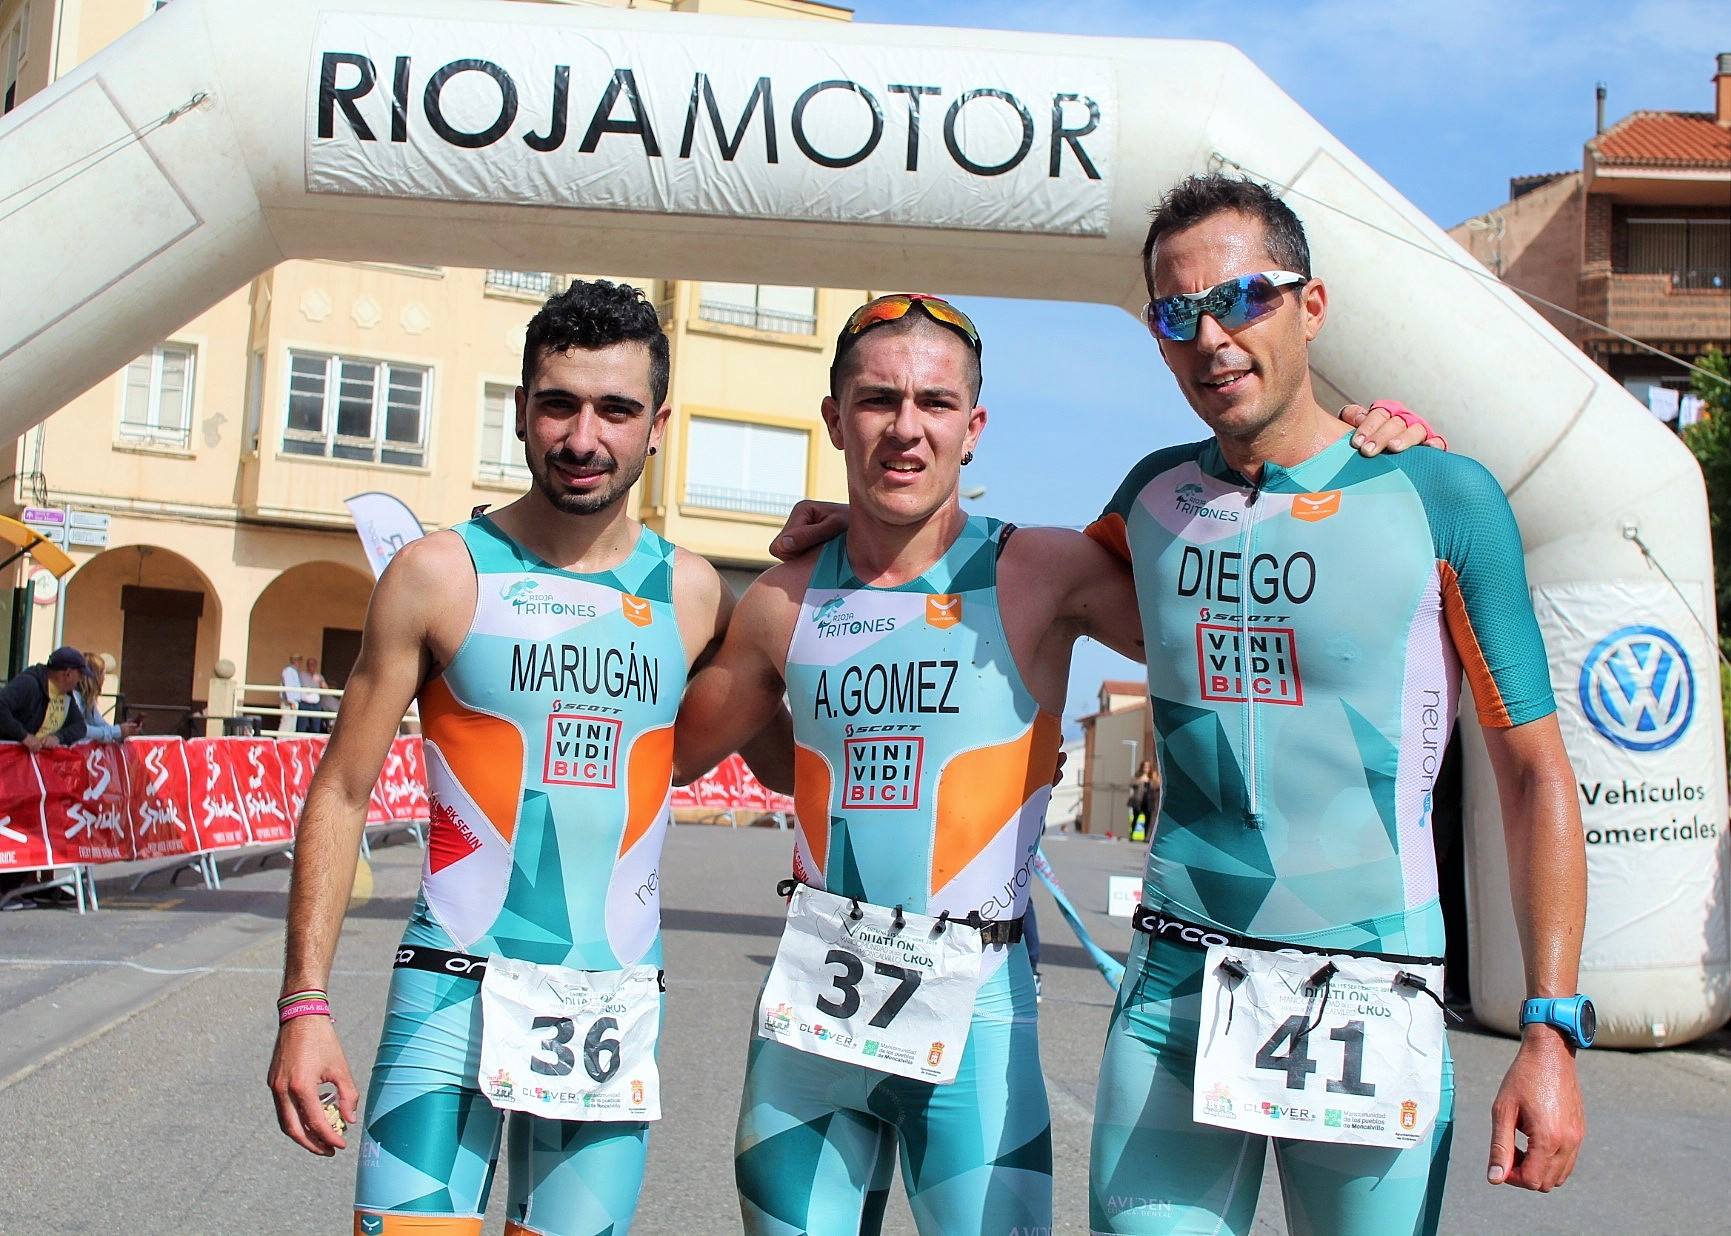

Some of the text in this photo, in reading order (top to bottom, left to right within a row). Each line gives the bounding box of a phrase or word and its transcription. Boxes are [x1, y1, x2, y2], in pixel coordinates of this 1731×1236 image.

[317, 52, 1102, 180] RIOJAMOTOR
[1176, 501, 1239, 523] TRITONES
[1177, 545, 1317, 605] DIEGO
[515, 603, 596, 618] TRITONES
[832, 612, 855, 622] RIOJA
[1212, 612, 1291, 623] SCOTT
[817, 617, 896, 639] TRITONES
[1208, 632, 1282, 653] VINI
[510, 641, 659, 705] MARUGÁN
[1209, 654, 1286, 675] VIDI
[814, 660, 960, 720] A.GOMEZ
[1211, 675, 1288, 696] BICI
[561, 702, 623, 714] SCOTT
[556, 722, 612, 741] VINI
[855, 723, 922, 734] SCOTT
[555, 742, 610, 760] VIDI
[1420, 690, 1441, 793] neuron
[852, 744, 912, 762] VINI
[553, 761, 608, 780] BICI
[852, 764, 911, 782] VIDI
[850, 784, 909, 801] BICI
[1580, 778, 1705, 806] Vehículos
[1585, 815, 1717, 845] omerciales
[815, 949, 924, 1030] 37
[530, 1016, 621, 1084] 36
[1255, 1014, 1376, 1098] 41
